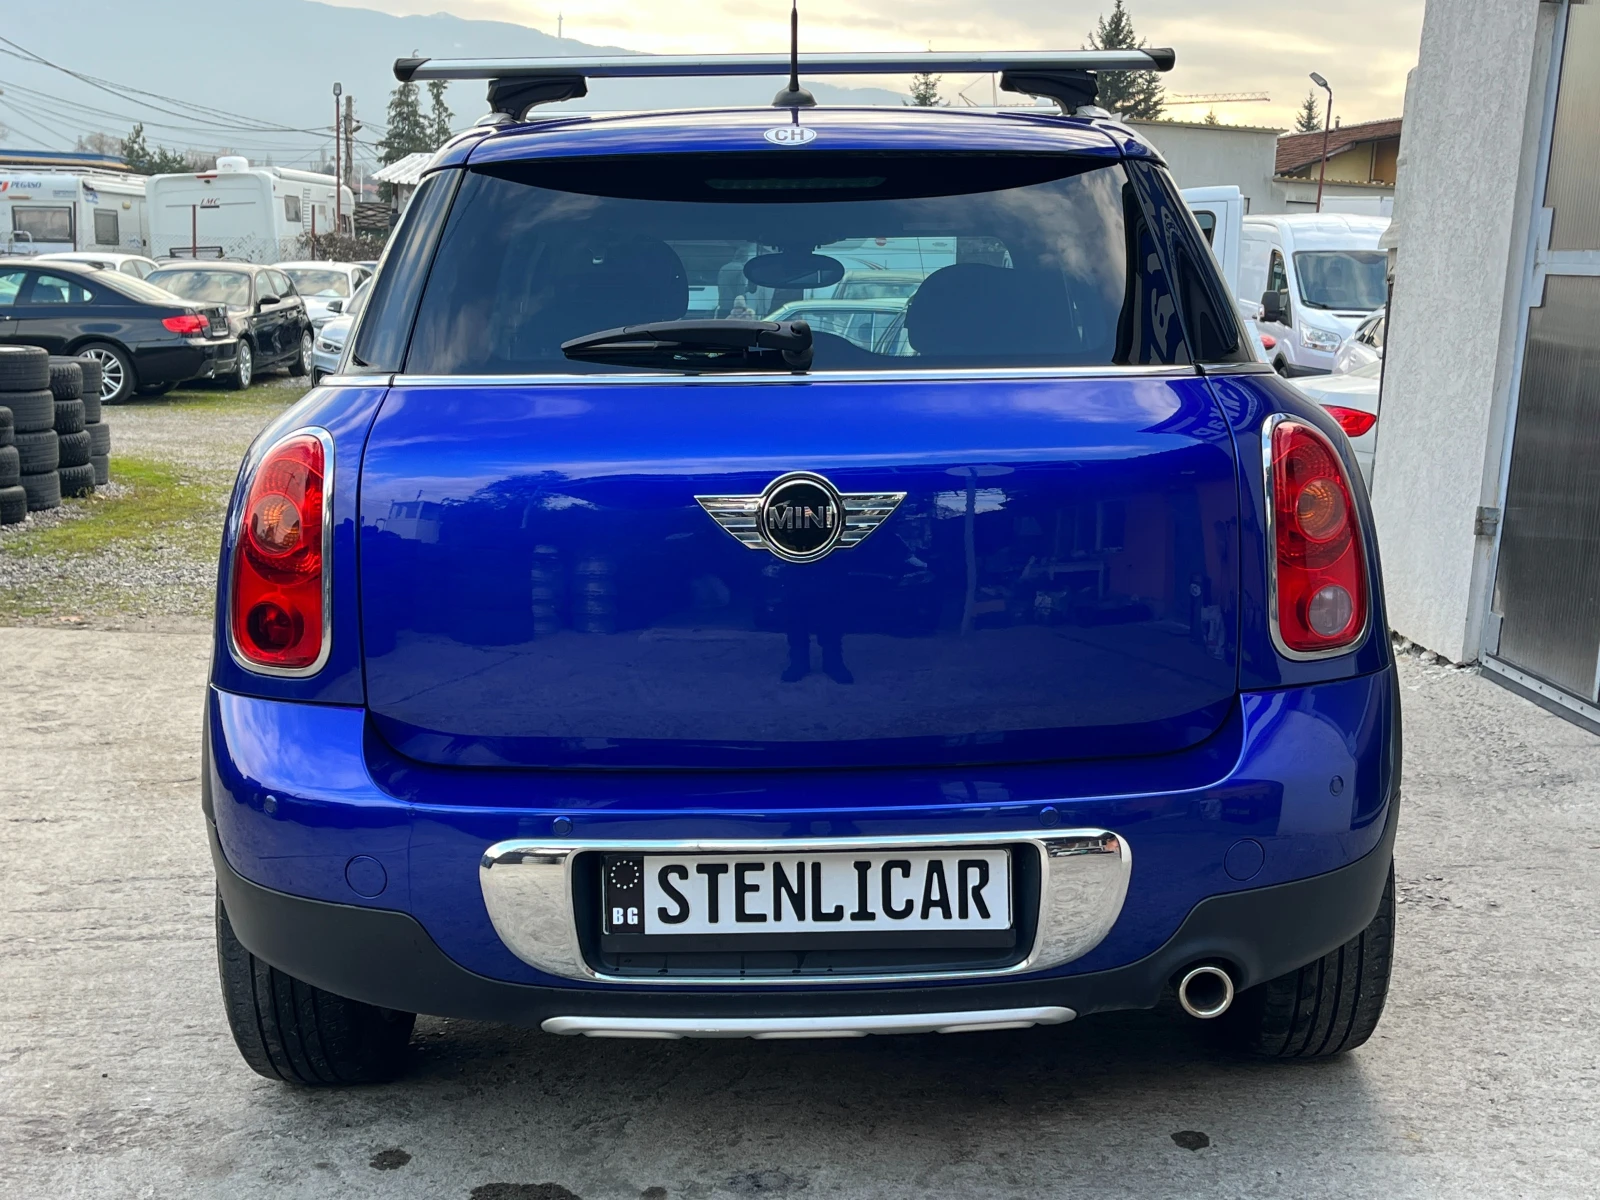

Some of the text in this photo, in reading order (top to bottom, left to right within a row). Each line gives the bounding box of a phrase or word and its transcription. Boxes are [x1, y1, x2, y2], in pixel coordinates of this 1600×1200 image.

[774, 129, 805, 142] CH
[10, 181, 42, 189] PEGASO
[769, 505, 834, 530] MINI
[612, 858, 993, 926] BG STENLICAR
